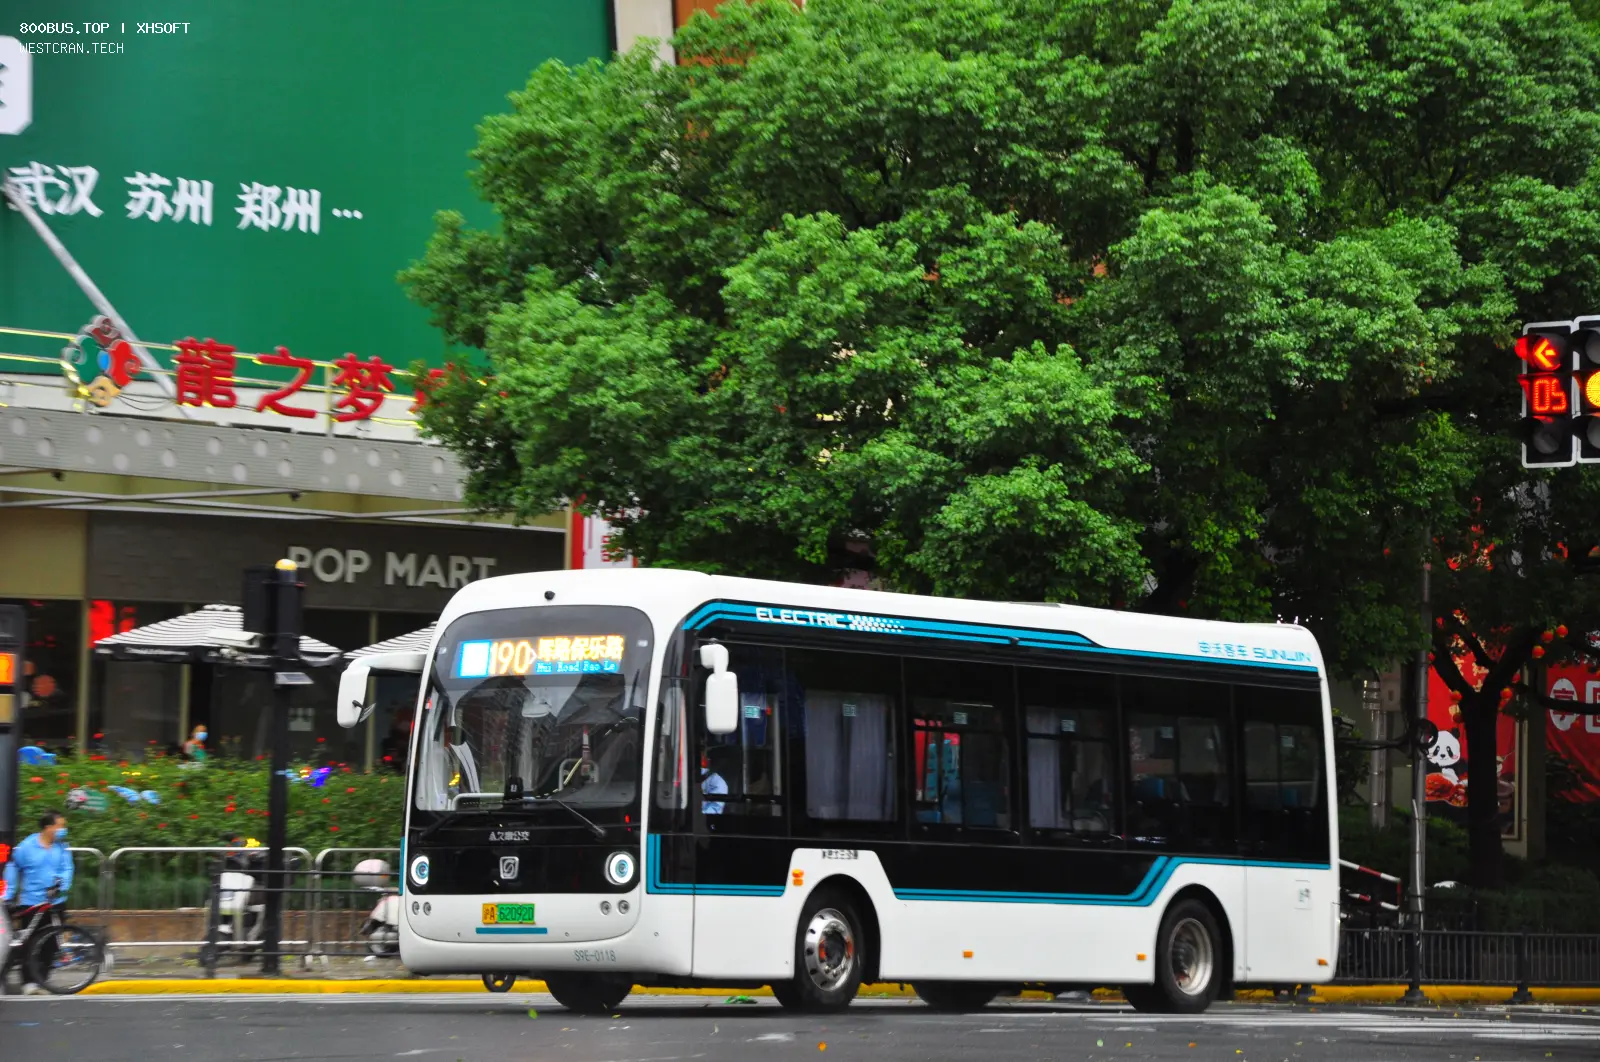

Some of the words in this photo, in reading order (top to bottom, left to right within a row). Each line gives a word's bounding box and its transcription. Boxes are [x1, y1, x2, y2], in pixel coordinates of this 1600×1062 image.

[5, 161, 103, 217] 武汉
[124, 171, 214, 227] 苏州
[171, 336, 452, 423] 龍之梦
[1532, 377, 1568, 413] 05
[288, 546, 372, 583] POP
[384, 551, 497, 588] MART
[755, 607, 847, 629] ELECTRIC
[489, 638, 532, 675] 190
[556, 660, 580, 673] Road
